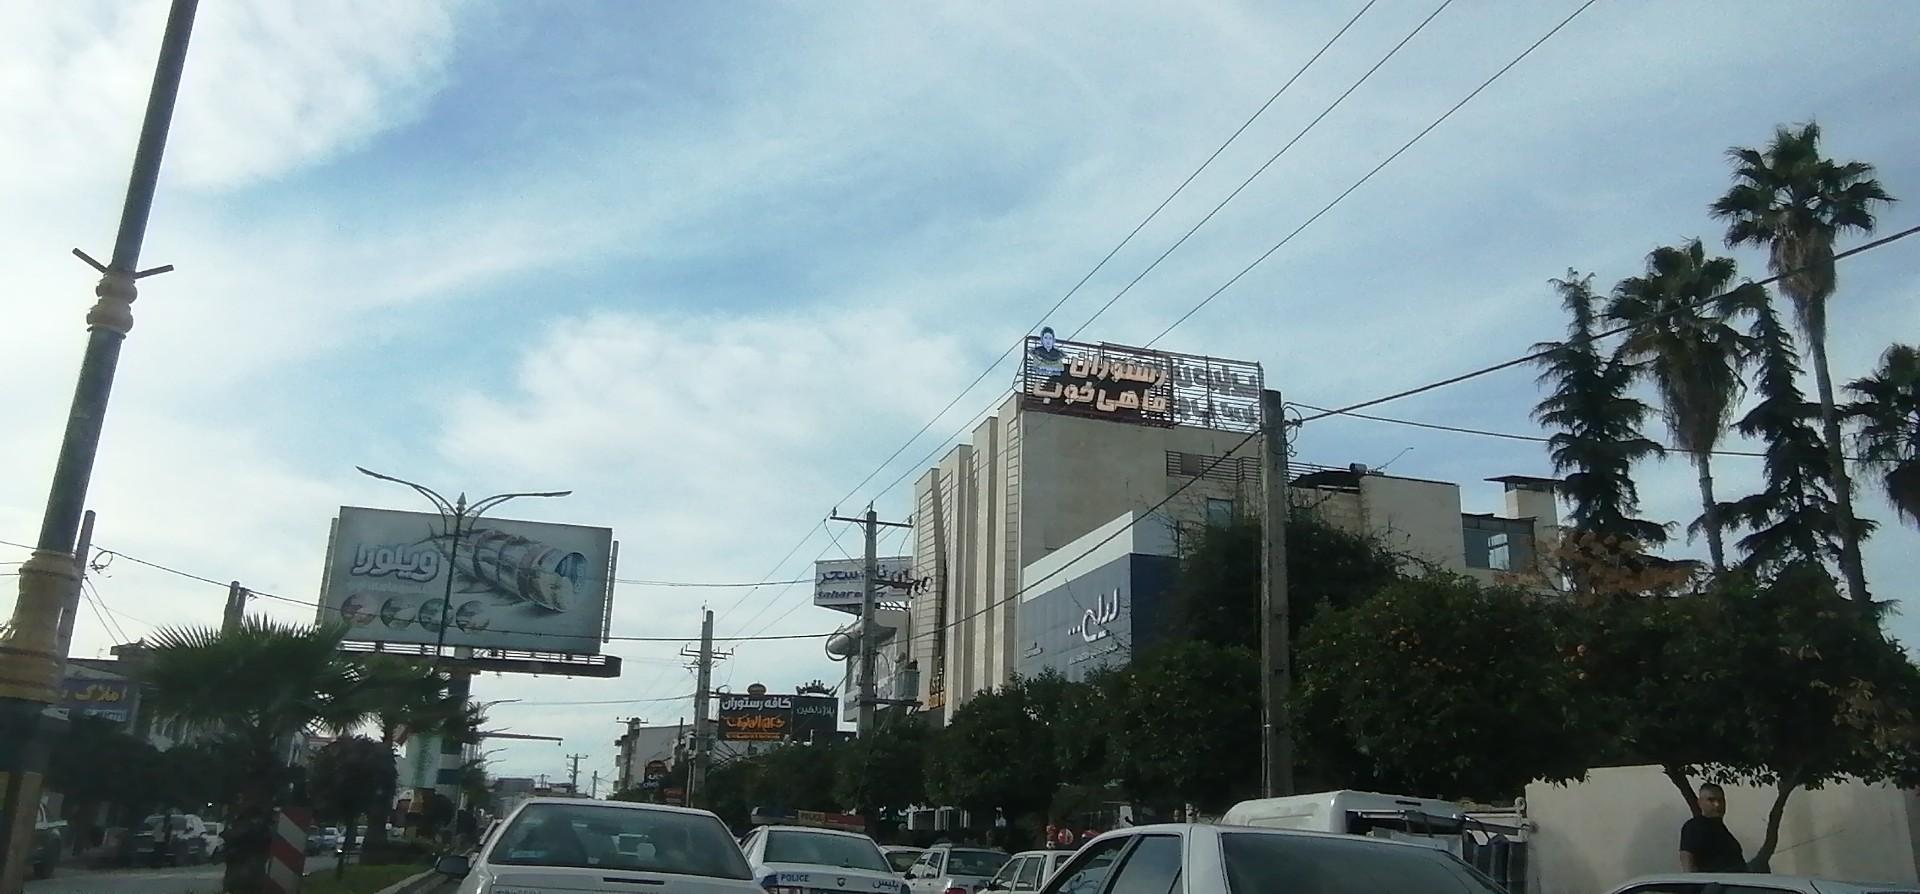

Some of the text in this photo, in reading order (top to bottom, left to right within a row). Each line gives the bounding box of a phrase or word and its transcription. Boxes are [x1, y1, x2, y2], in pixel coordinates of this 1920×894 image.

[1069, 351, 1167, 387] رستوران
[1032, 379, 1096, 405] خوب
[1096, 388, 1168, 413] ماهی
[74, 684, 127, 702] املاک
[721, 697, 792, 711] کافه رستوران
[780, 873, 809, 883] POLICE
[872, 878, 900, 891] پلیس
